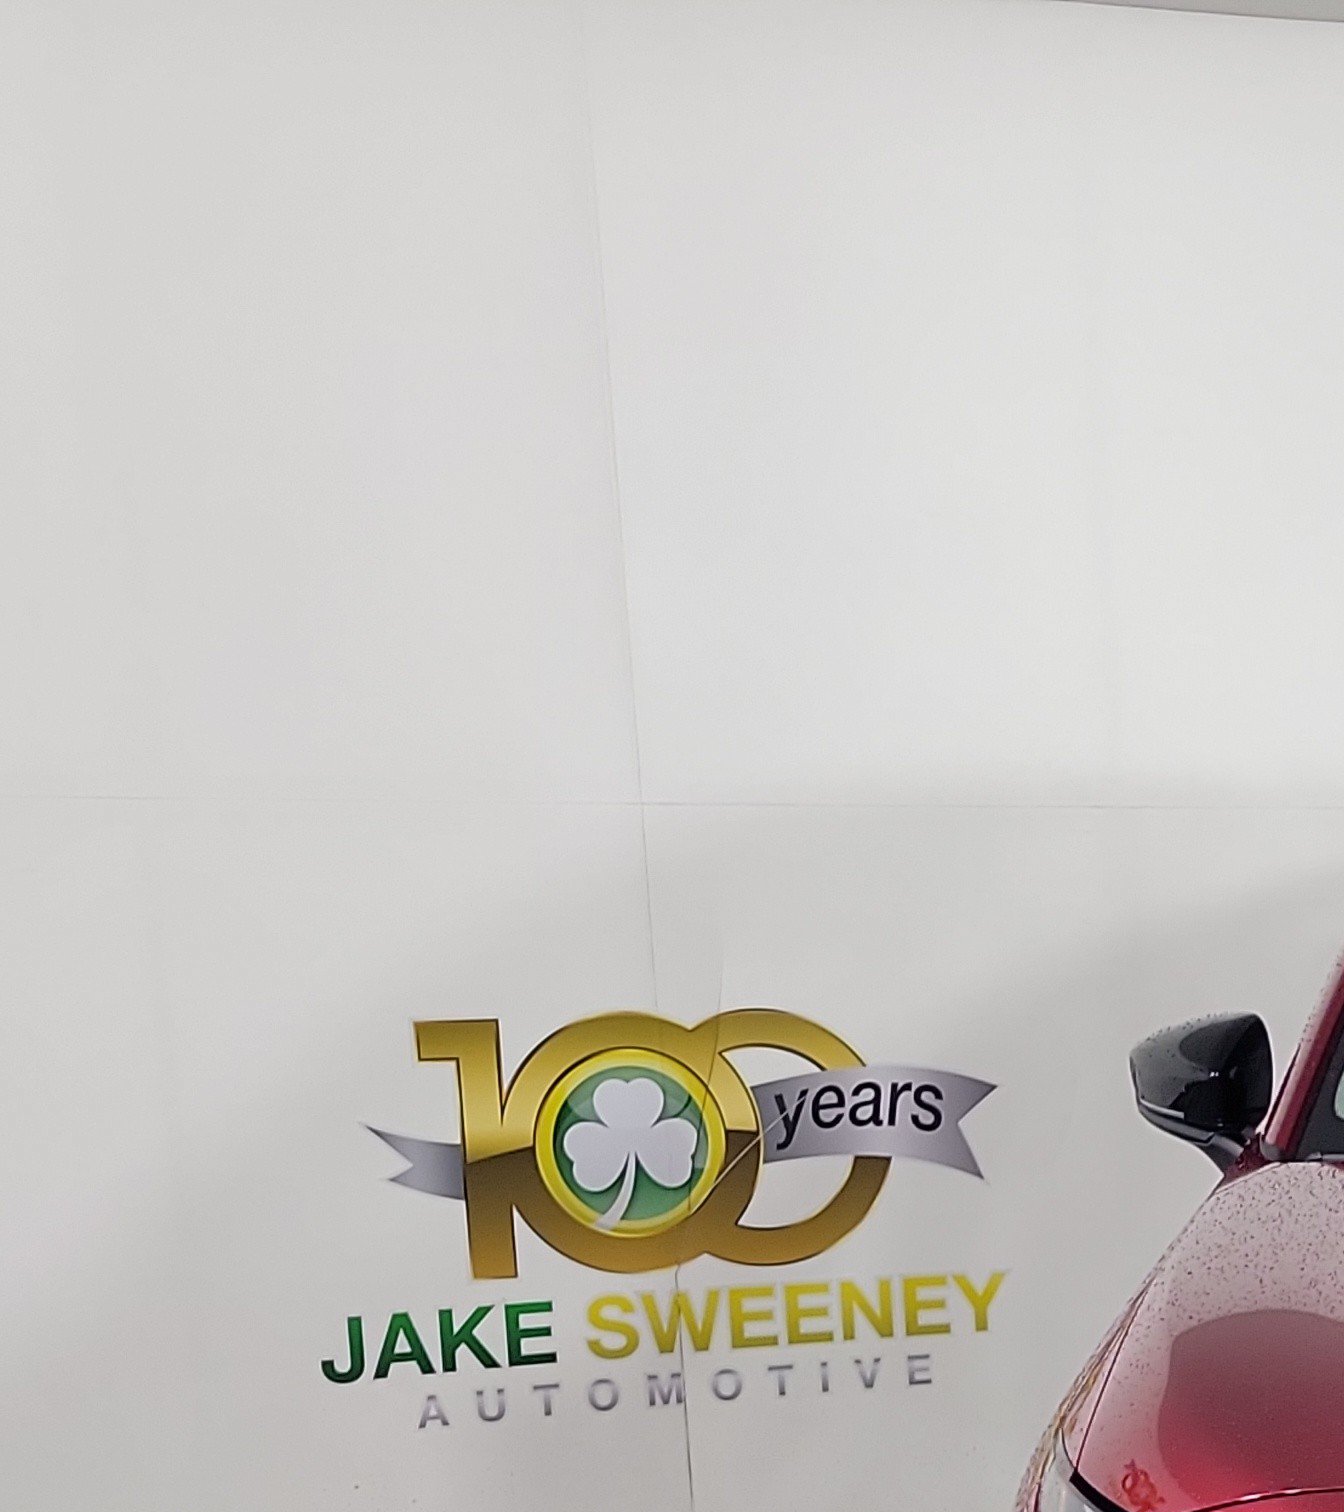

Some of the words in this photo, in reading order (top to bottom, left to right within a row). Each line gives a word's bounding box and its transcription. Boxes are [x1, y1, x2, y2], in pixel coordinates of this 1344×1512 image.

[412, 1007, 892, 1280] 100
[773, 1079, 944, 1151] years
[320, 1300, 558, 1384] JAKE
[585, 1272, 1008, 1360] SWEENEY
[417, 1354, 934, 1430] AUTOMOTIVE
